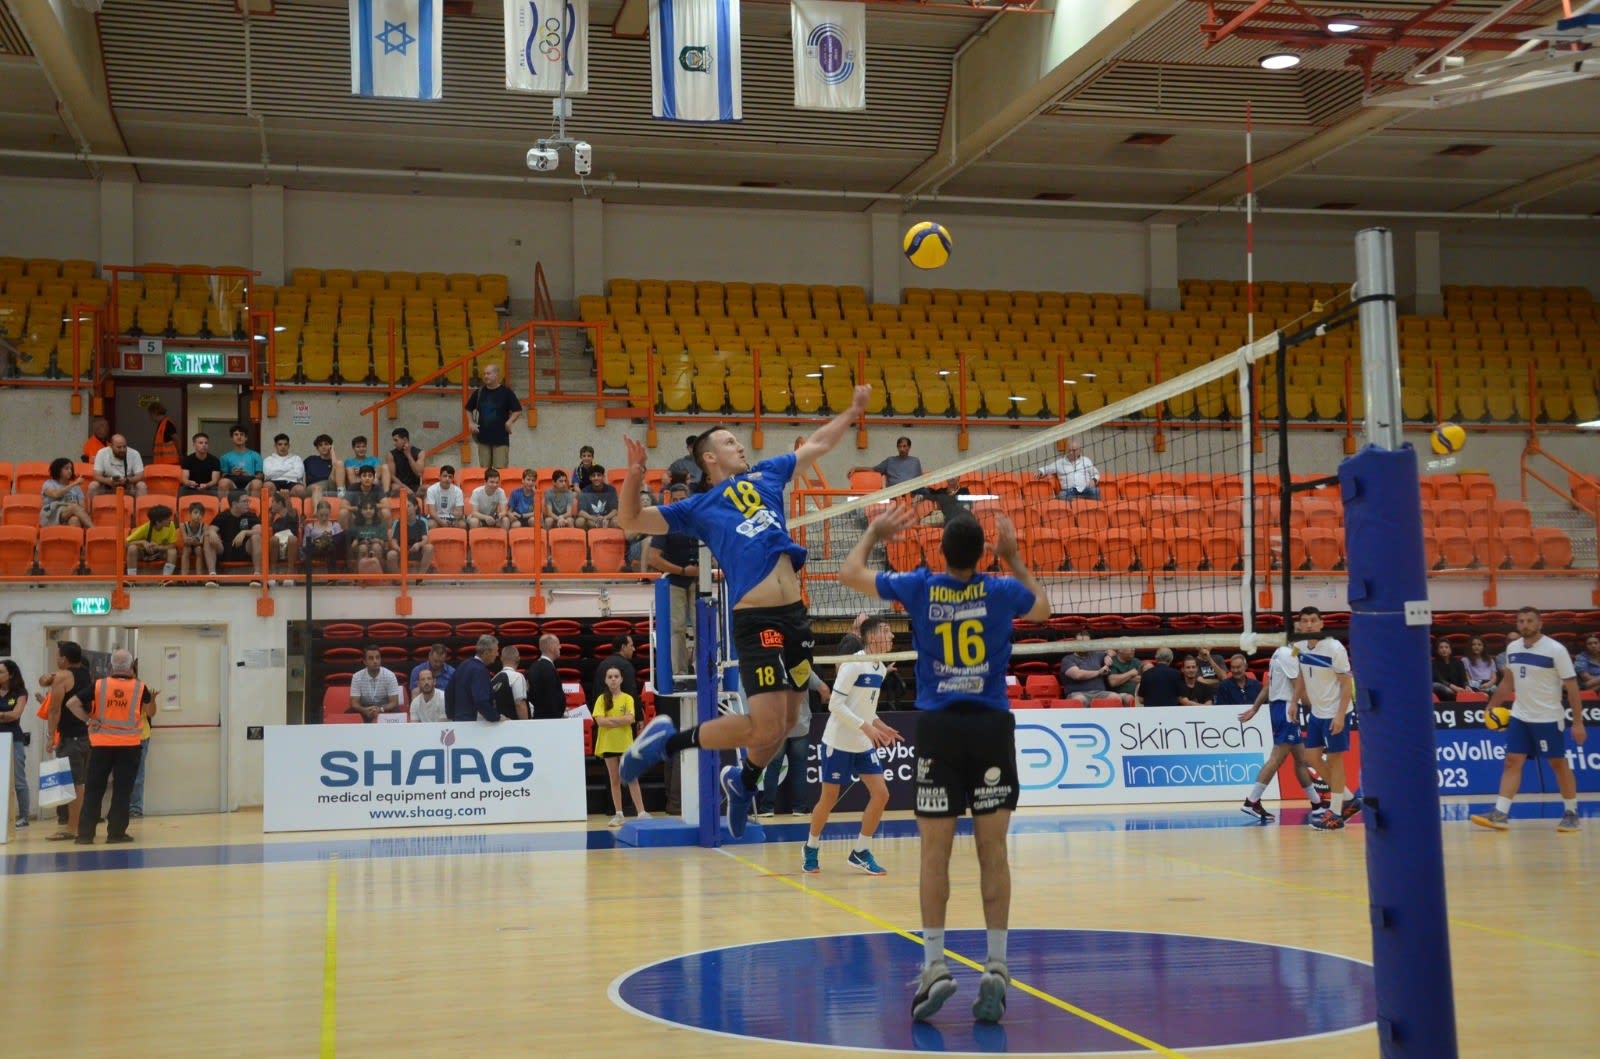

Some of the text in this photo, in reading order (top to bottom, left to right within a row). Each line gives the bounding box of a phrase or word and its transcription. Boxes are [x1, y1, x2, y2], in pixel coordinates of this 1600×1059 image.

[147, 341, 156, 353] 5
[186, 353, 219, 374] יציאה
[722, 480, 763, 514] 18
[929, 581, 988, 604] HOROVITZ
[76, 597, 106, 614] יציאה
[934, 619, 986, 668] 16
[755, 665, 776, 687] 18
[1519, 666, 1527, 678] 9
[1539, 739, 1548, 753] 9
[320, 746, 535, 788] SHAAG
[1127, 759, 1265, 785] Innovation
[317, 786, 531, 804] medical equipment and projects
[369, 806, 487, 819] www.shaag.com
